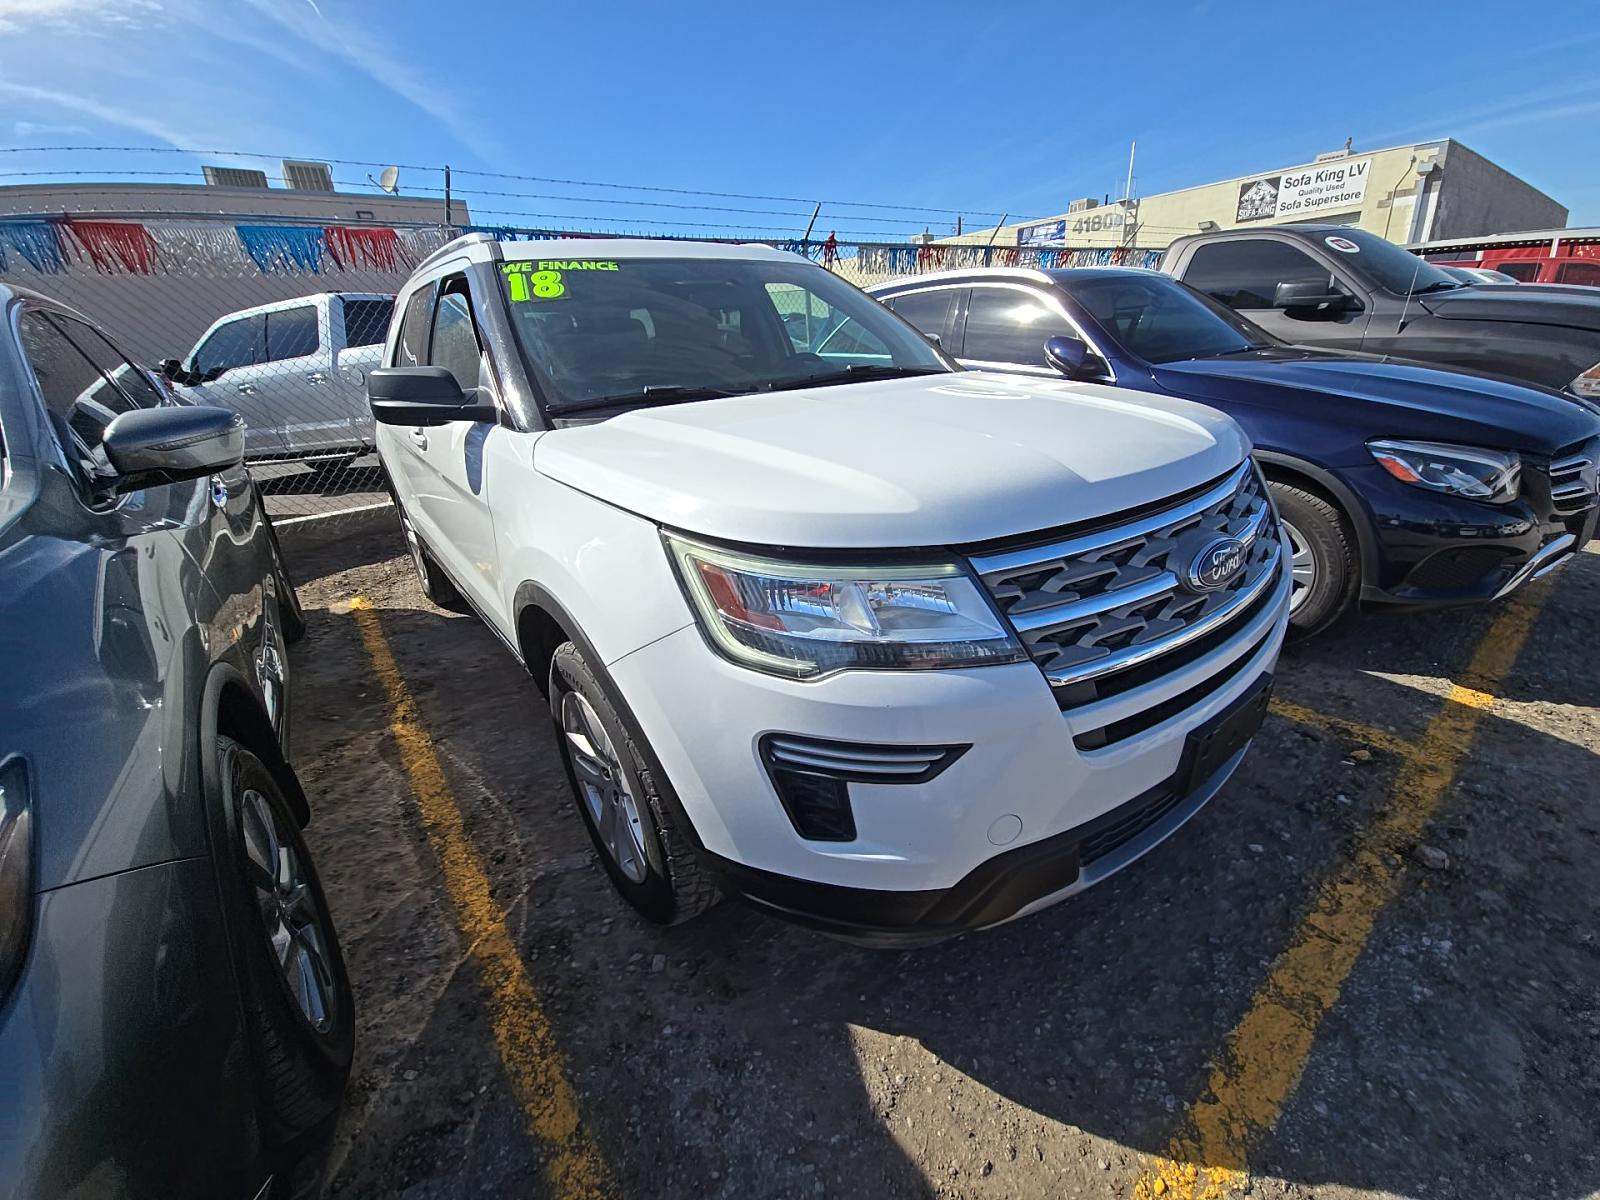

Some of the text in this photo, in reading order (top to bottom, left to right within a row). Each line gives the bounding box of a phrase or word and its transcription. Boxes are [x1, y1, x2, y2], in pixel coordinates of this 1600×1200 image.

[1284, 162, 1367, 189] Sofa King LV
[1280, 191, 1361, 211] Sofa Superstore
[1298, 182, 1345, 197] Quality Used
[501, 261, 619, 273] WE FINANCE
[508, 270, 565, 302] 18
[1212, 547, 1240, 580] Ford
